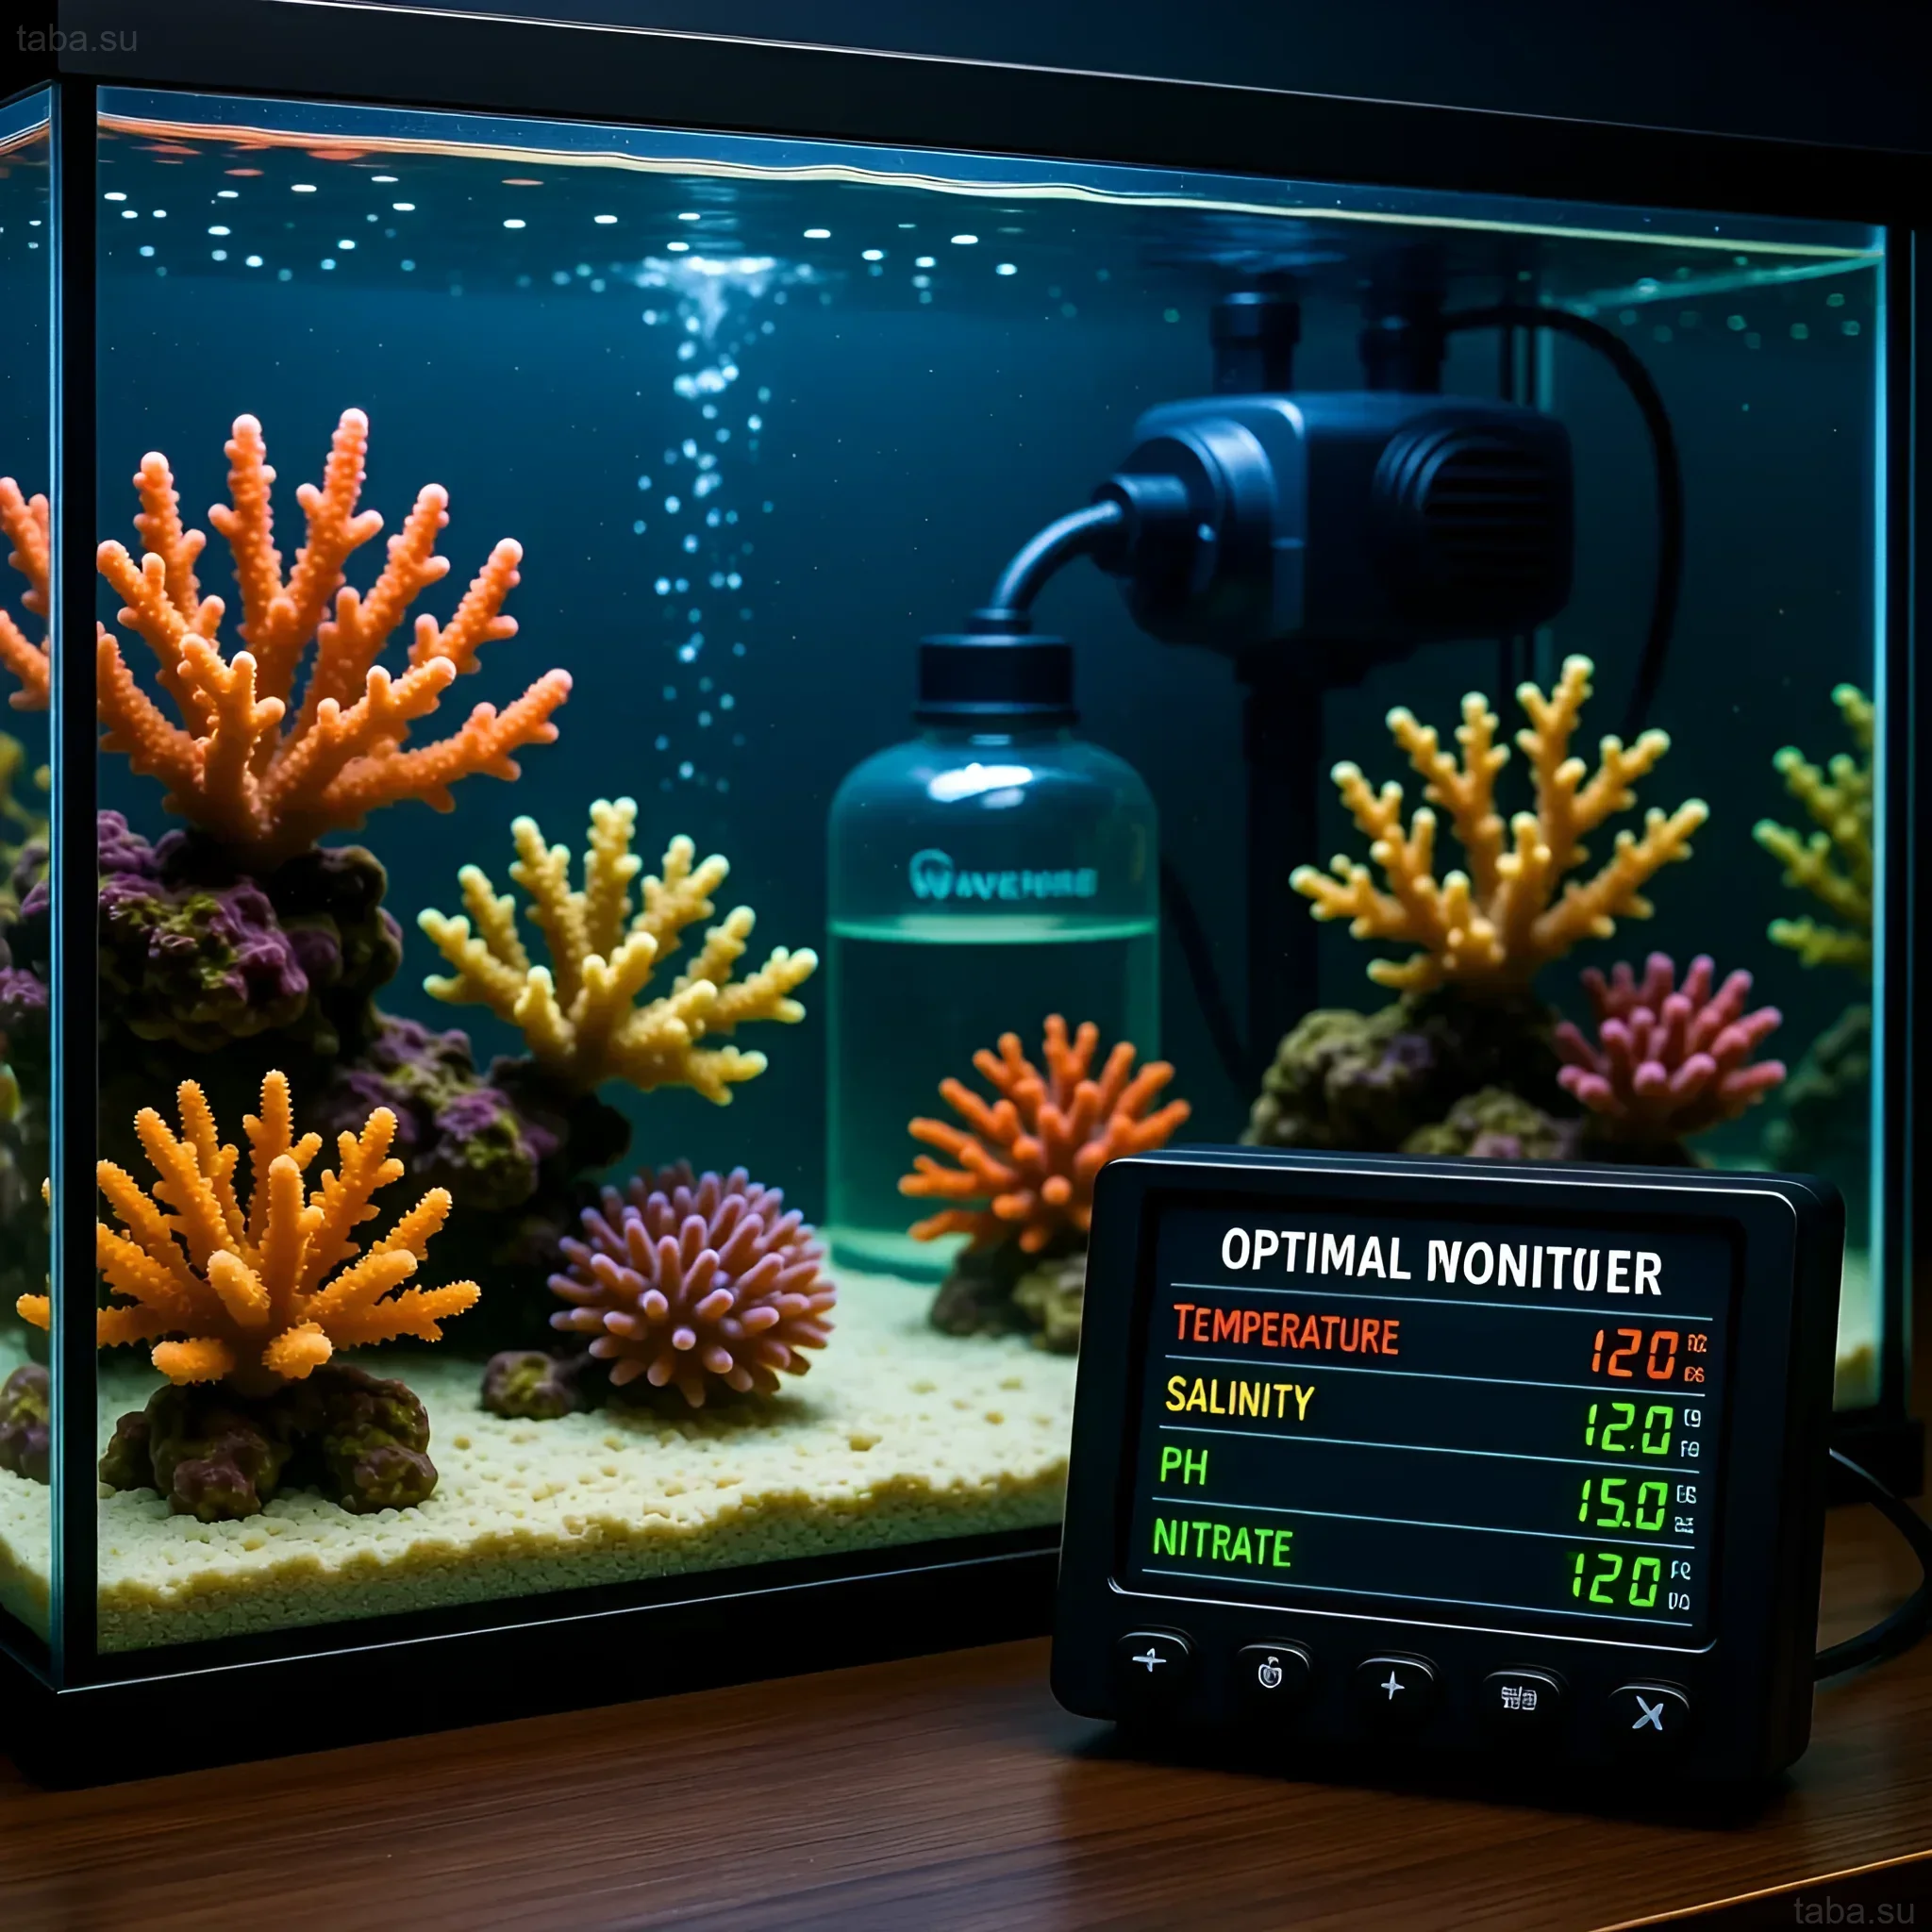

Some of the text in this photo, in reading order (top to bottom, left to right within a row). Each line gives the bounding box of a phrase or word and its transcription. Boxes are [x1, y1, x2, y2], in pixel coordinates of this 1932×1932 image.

[1221, 1226, 1412, 1281] OPTIMAL
[1173, 1303, 1679, 1380] TEMPERATURE 120
[1164, 1374, 1674, 1455] SALINITY 12.0
[1159, 1446, 1208, 1486] PH
[1577, 1477, 1669, 1531] 15.0
[1152, 1517, 1661, 1607] NITRATE 120
